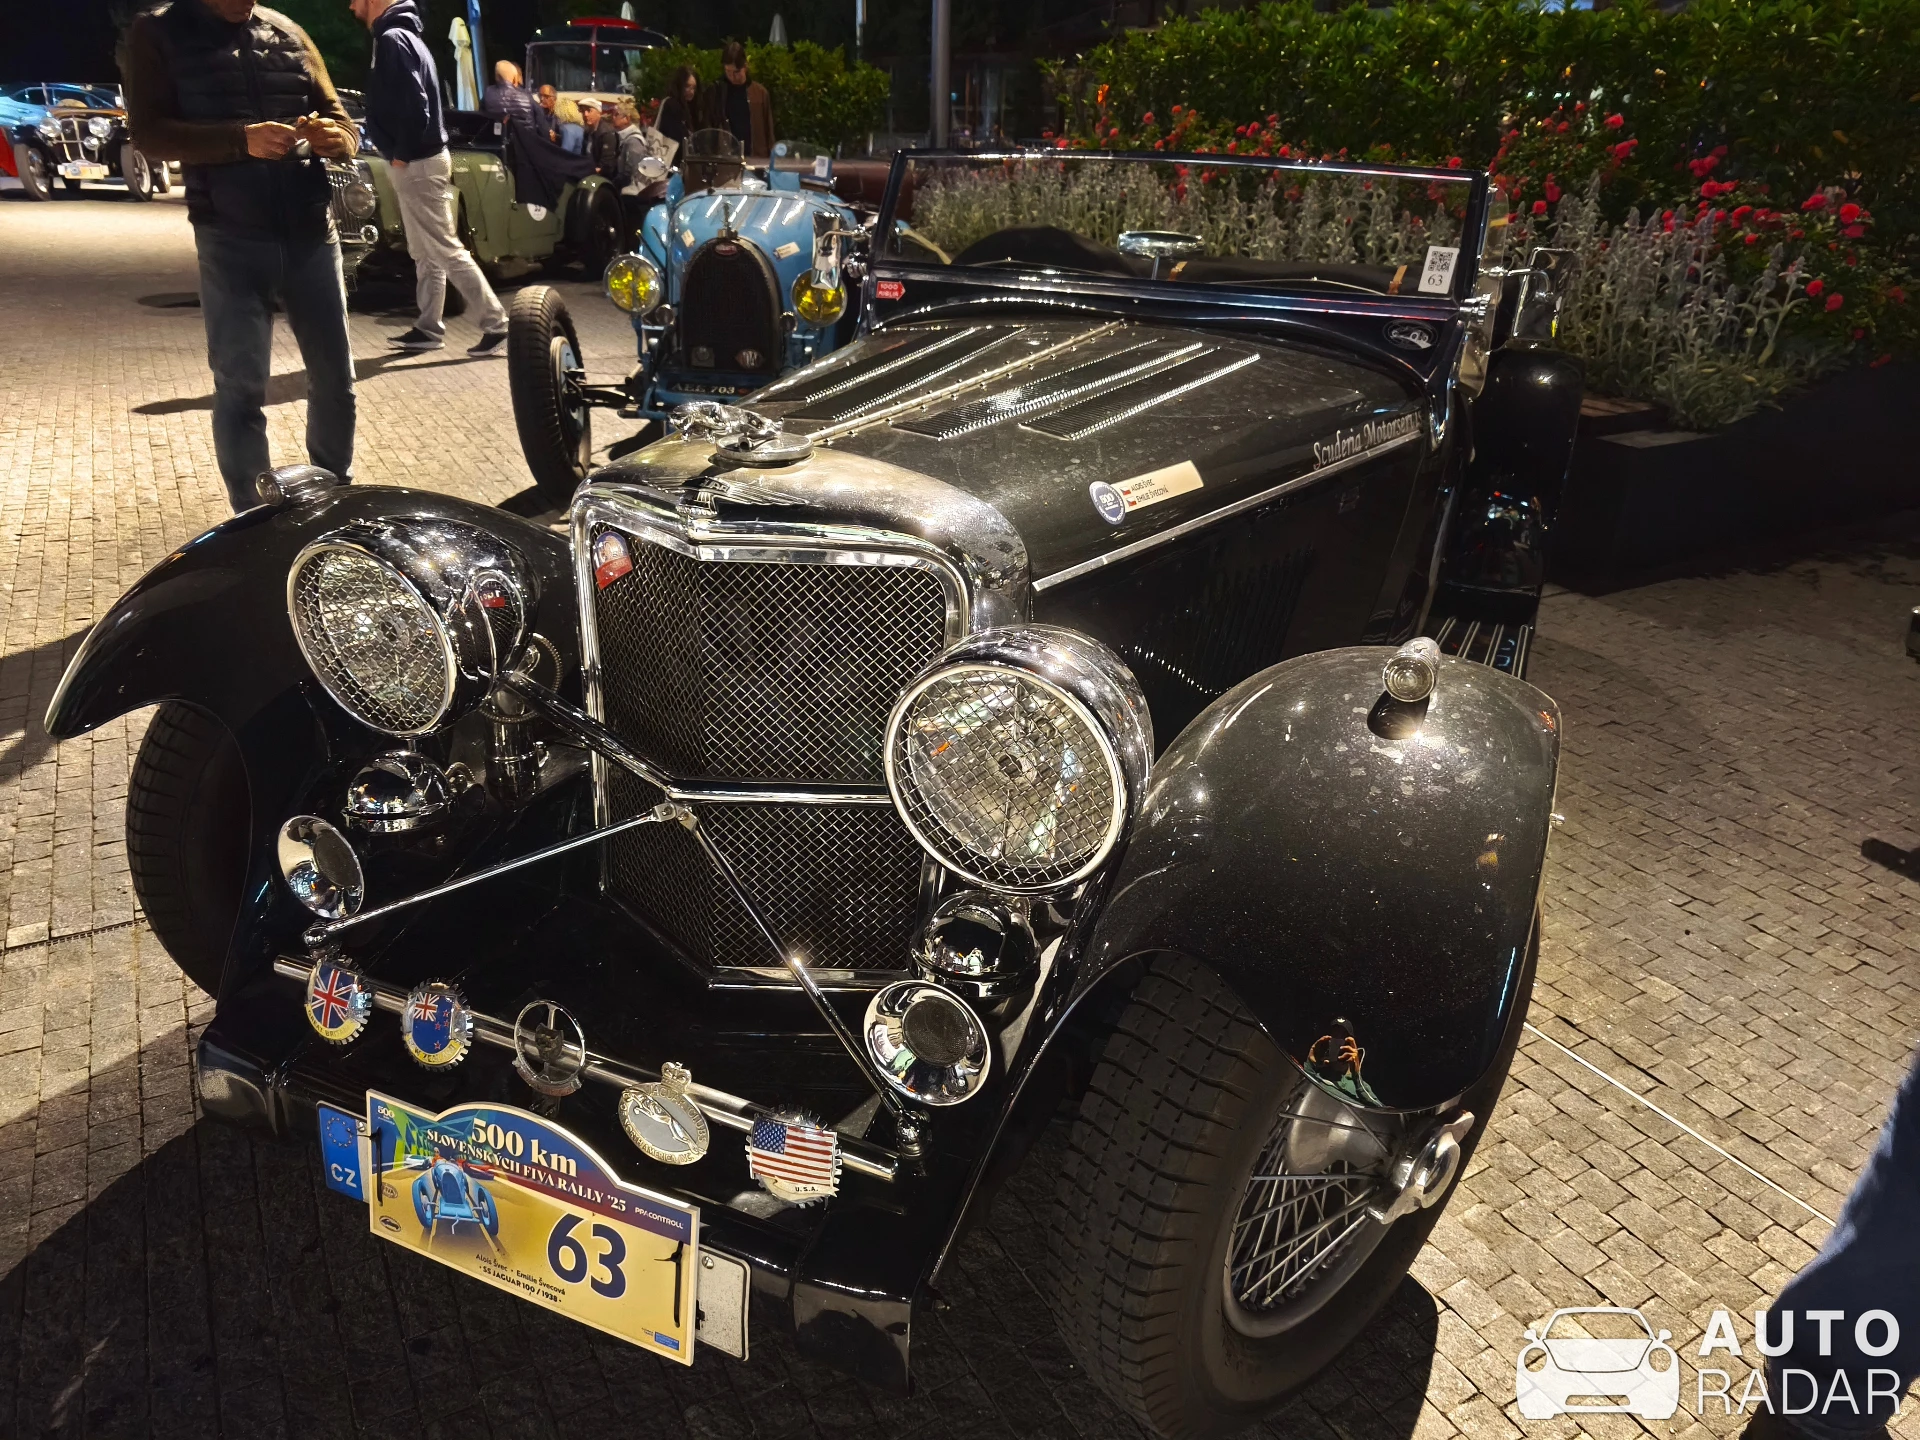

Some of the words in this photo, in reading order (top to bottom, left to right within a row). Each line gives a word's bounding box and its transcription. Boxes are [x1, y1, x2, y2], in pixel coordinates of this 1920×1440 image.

[1428, 274, 1443, 286] 63
[710, 386, 736, 395] 703
[1313, 428, 1362, 471] Scuderia
[377, 1105, 400, 1118] 500
[427, 1129, 520, 1174] SLOVENSKÝCH
[523, 1165, 555, 1187] FIVA
[557, 1177, 604, 1203] RALLY
[472, 1117, 524, 1157] 500
[530, 1139, 577, 1178] km
[331, 1163, 357, 1188] CZ
[476, 1253, 492, 1265] Alois
[493, 1258, 508, 1272] Švec
[516, 1269, 538, 1285] Emilie
[538, 1277, 566, 1296] Švecová
[547, 1213, 627, 1299] 63
[483, 1266, 491, 1275] SS
[493, 1270, 521, 1288] JAGUAR
[522, 1282, 535, 1293] 100
[541, 1290, 558, 1303] 1938
